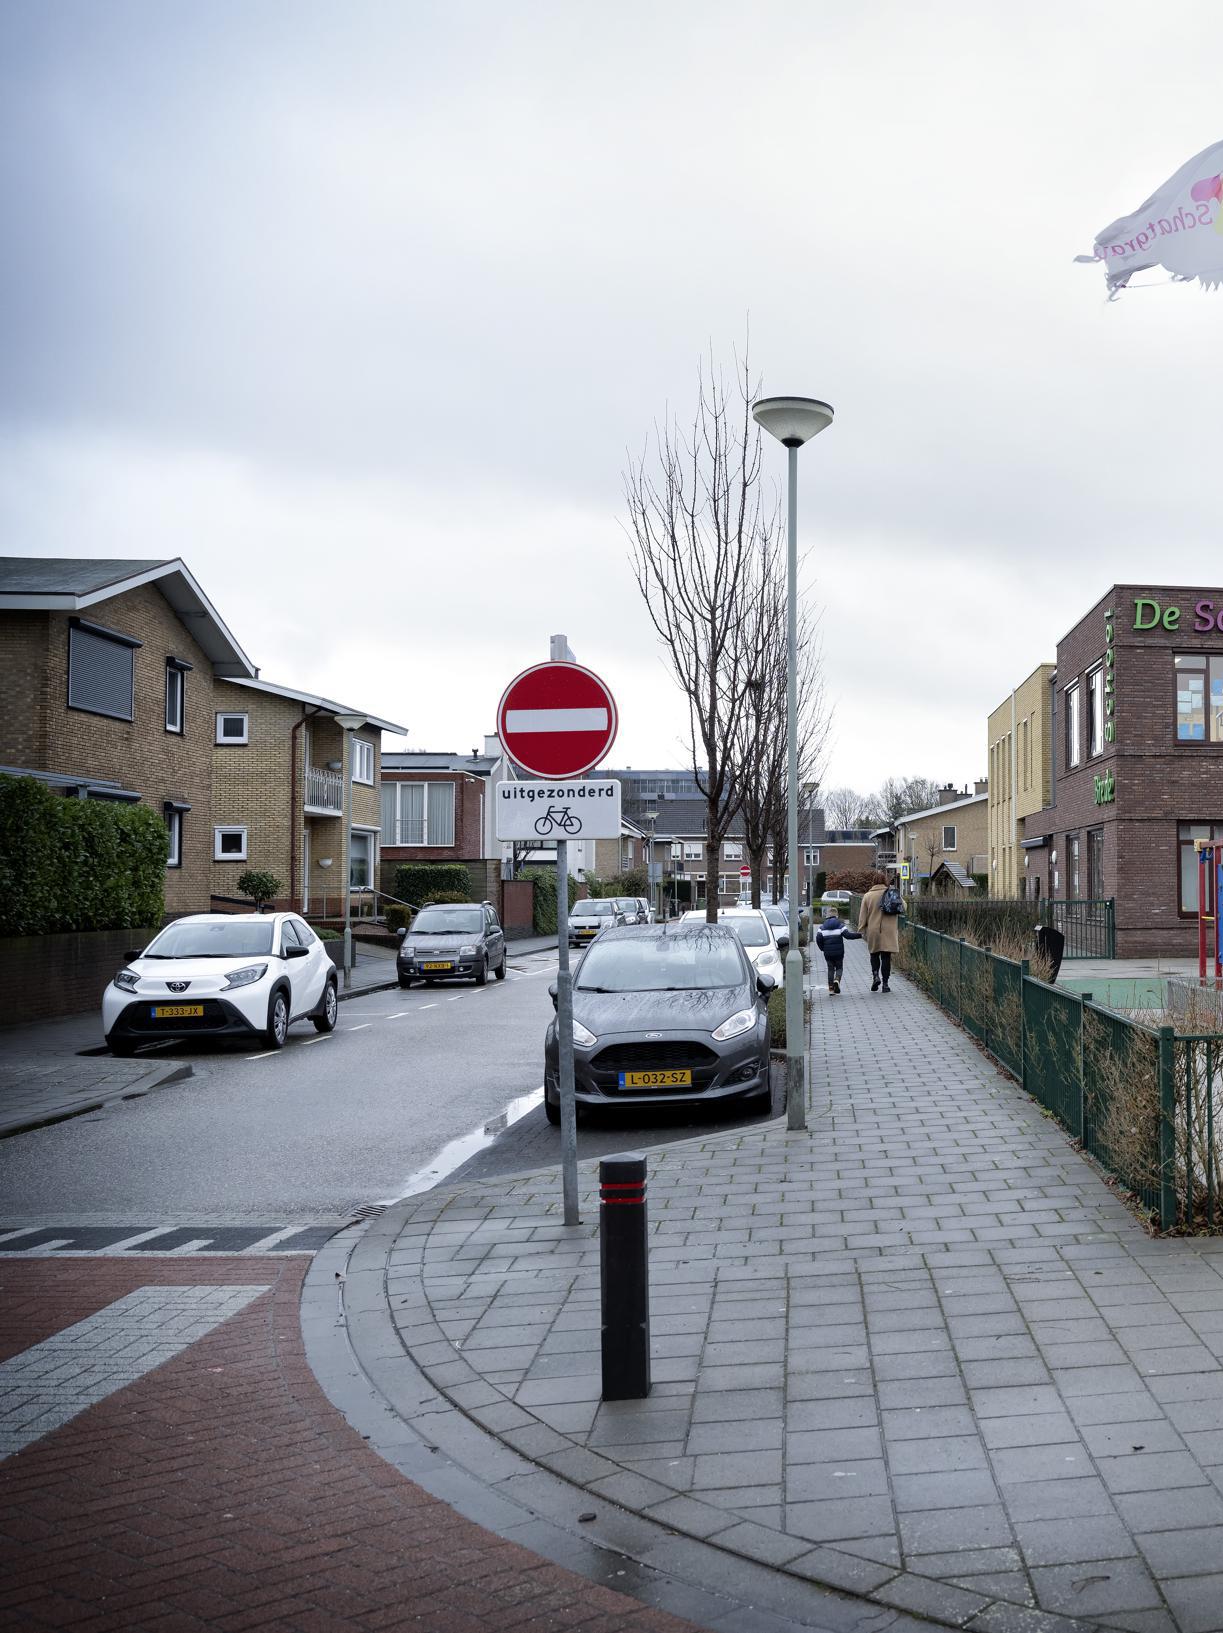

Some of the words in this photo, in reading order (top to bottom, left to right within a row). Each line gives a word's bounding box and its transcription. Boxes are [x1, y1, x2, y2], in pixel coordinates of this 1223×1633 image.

[1133, 599, 1181, 631] De
[502, 785, 614, 802] uitgezonderd
[160, 1007, 199, 1016] T-333-JX
[630, 1072, 687, 1085] L-032-SZ
